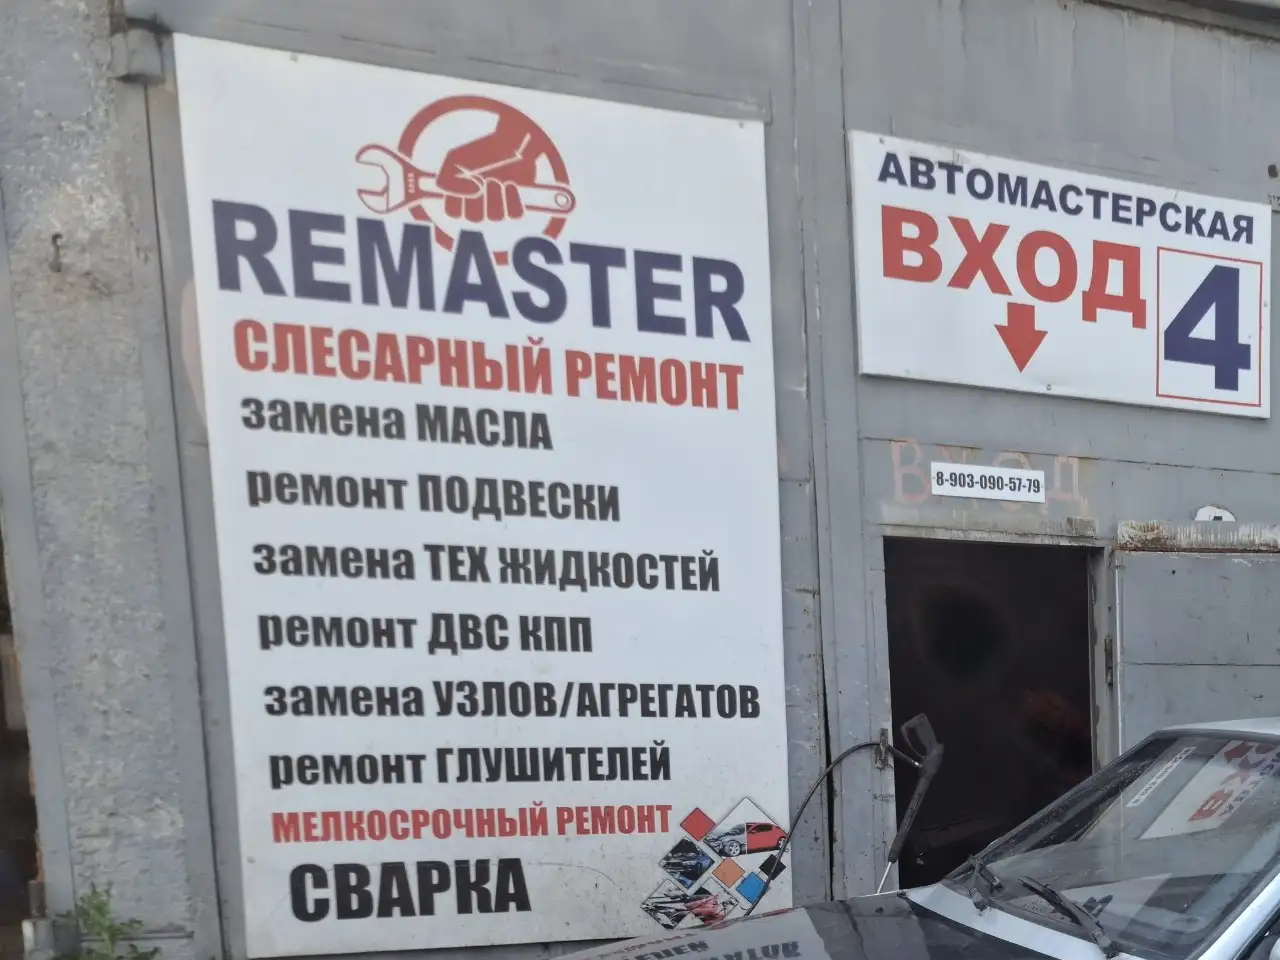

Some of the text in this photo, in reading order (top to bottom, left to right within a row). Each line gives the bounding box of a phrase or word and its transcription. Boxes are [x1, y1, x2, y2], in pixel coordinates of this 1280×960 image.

[877, 151, 1254, 245] АВТОМАСТЕРСКАЯ
[211, 199, 751, 343] REMASTER
[881, 204, 1147, 330] ВХОД
[1163, 264, 1252, 392] 4
[233, 319, 744, 411] СЛЕСАРНЫЙ РЕМОНТ
[240, 397, 554, 451] замена МАСЛА
[246, 470, 621, 522] ремонт ПОДВЕСКИ
[936, 471, 1041, 493] 8-903-090-57-79
[252, 543, 720, 593] замена ТЕХ ЖИДКОСТЕЙ
[258, 612, 593, 656] ремонт ДВС КПП
[263, 680, 761, 719] замена УЗЛОВ/АГРЕГАТОВ
[269, 740, 671, 790] ремонт ГЛУШИТЕЛЕЙ
[272, 801, 673, 844] МЕЛКОСРОЧНЫЙ РЕМОНТ
[289, 857, 533, 924] СВАРКА
